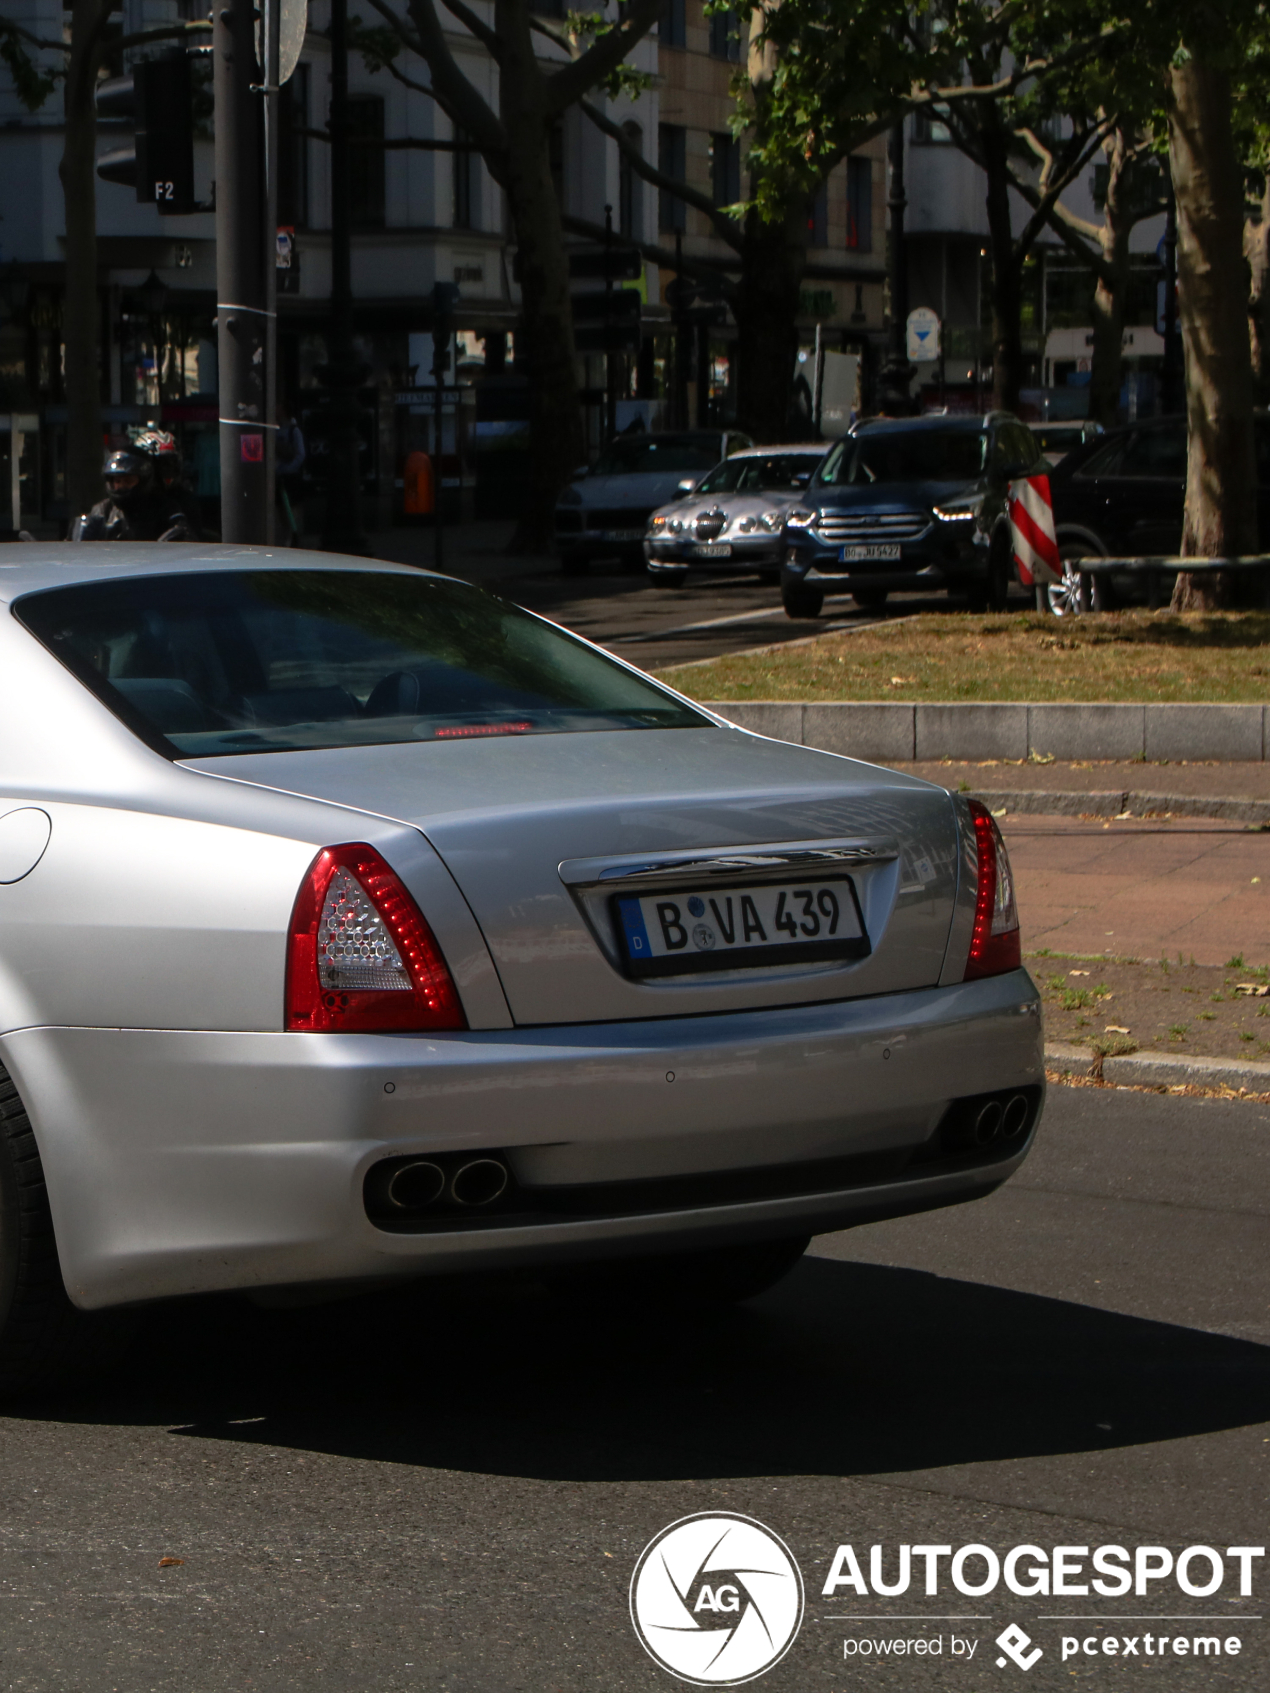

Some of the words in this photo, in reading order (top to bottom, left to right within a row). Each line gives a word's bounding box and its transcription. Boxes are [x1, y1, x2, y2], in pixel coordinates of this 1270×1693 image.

[155, 181, 174, 200] F2
[656, 902, 688, 950] B
[709, 895, 767, 944] VA
[775, 889, 839, 937] 439
[633, 936, 643, 950] D
